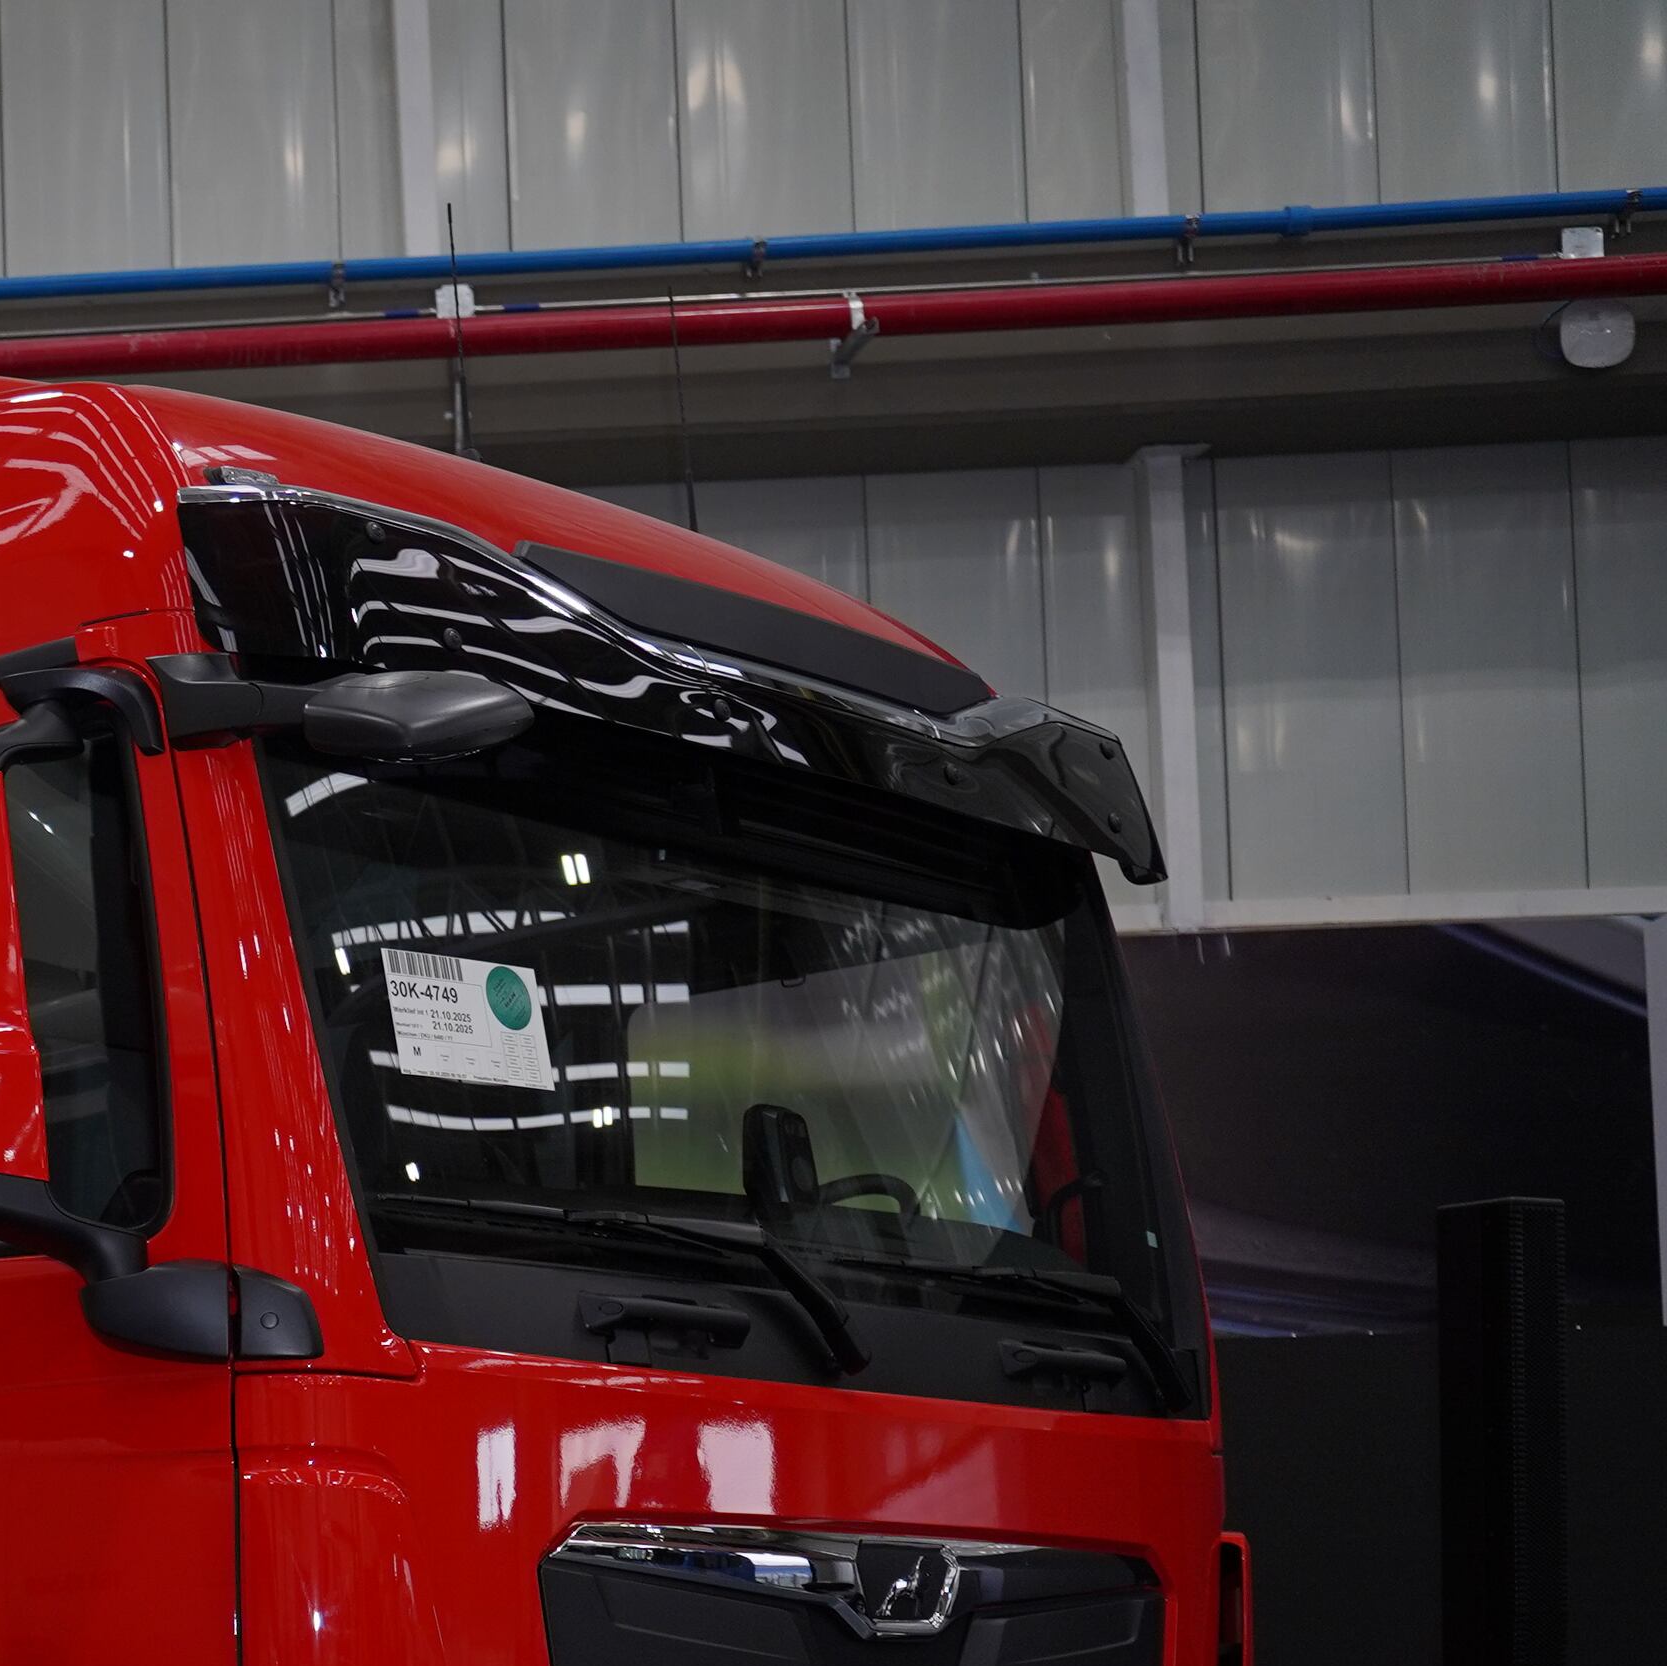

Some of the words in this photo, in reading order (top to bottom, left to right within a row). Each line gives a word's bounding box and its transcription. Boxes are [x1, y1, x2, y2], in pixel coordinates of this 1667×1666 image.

[389, 979, 459, 1004] 30K-4749
[430, 1009, 472, 1023] 21.10.2025
[432, 1021, 474, 1035] 21.10.2025
[413, 1046, 422, 1057] M
